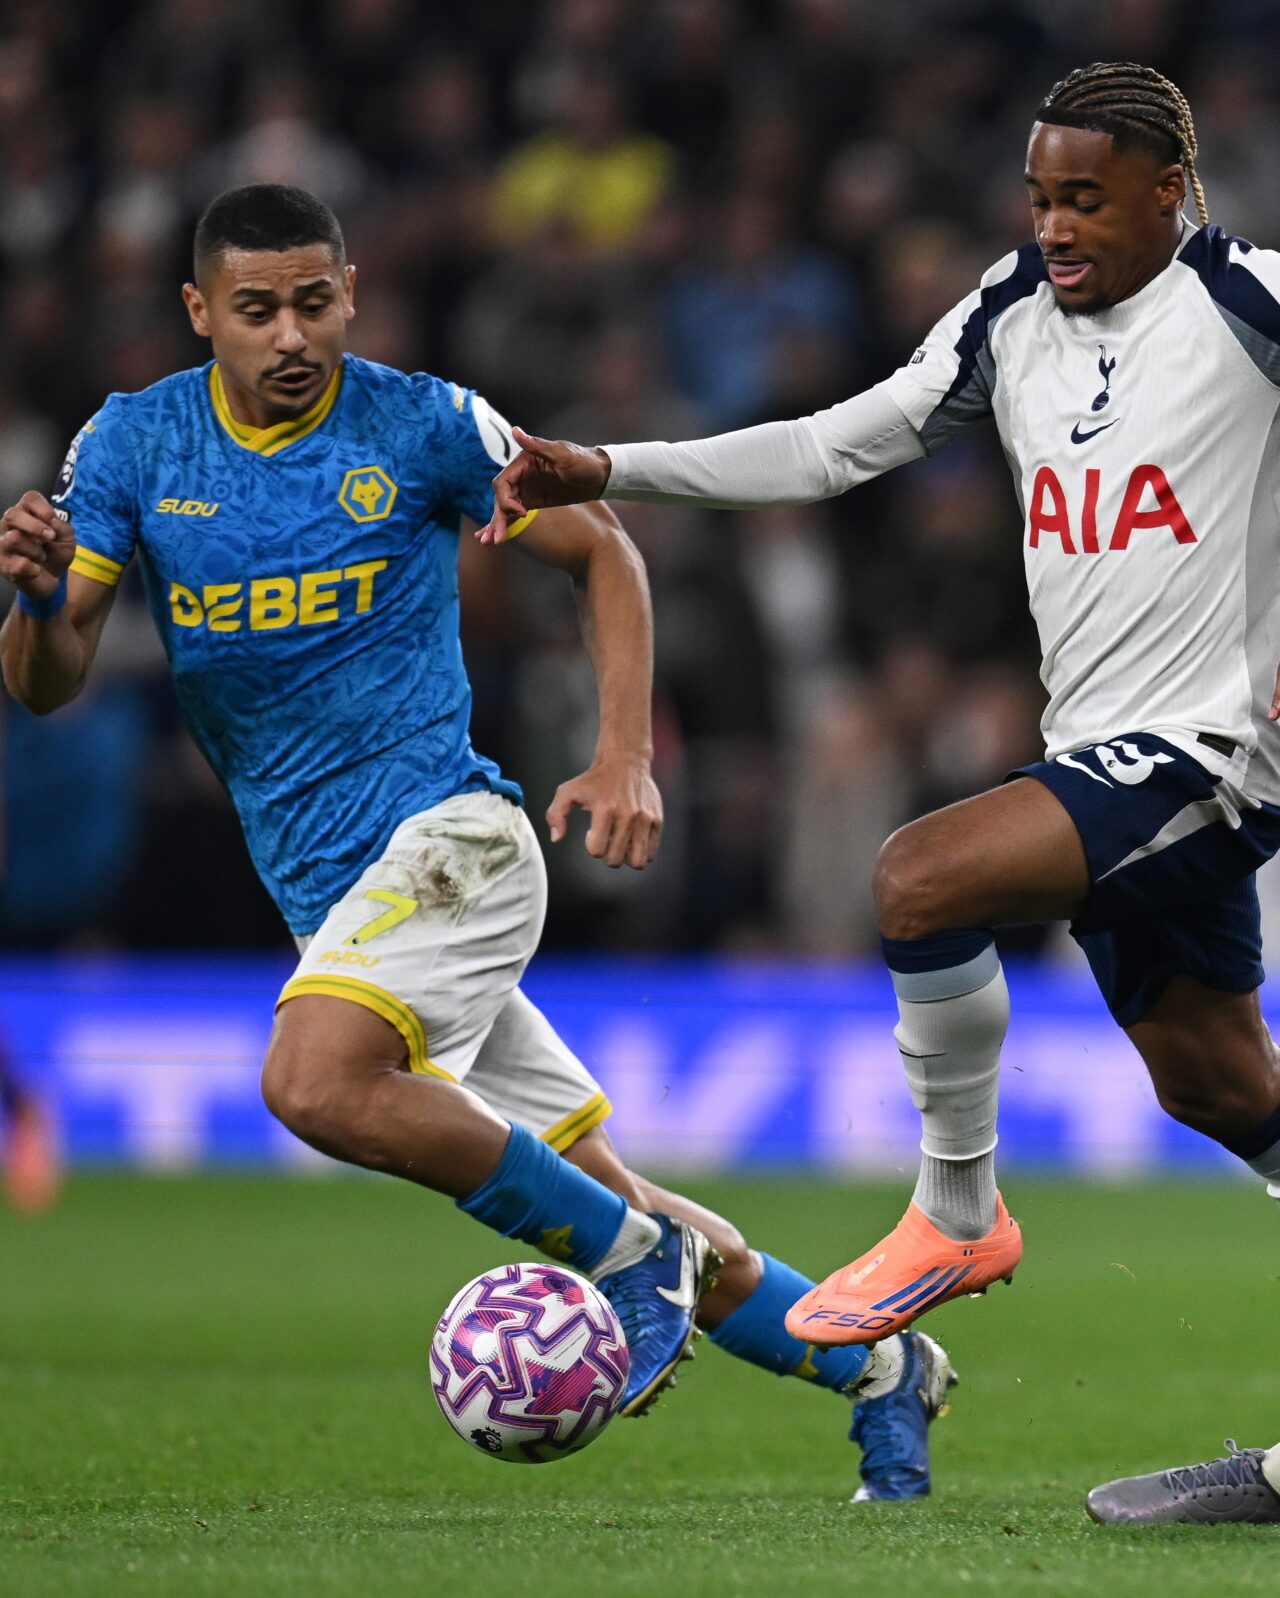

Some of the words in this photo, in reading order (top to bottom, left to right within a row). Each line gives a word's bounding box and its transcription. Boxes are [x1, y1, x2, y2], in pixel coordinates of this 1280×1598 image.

[155, 498, 219, 518] SUDU
[1028, 463, 1199, 555] AIA
[169, 559, 388, 633] DEBET
[341, 889, 419, 949] 7
[802, 1310, 896, 1331] F50
